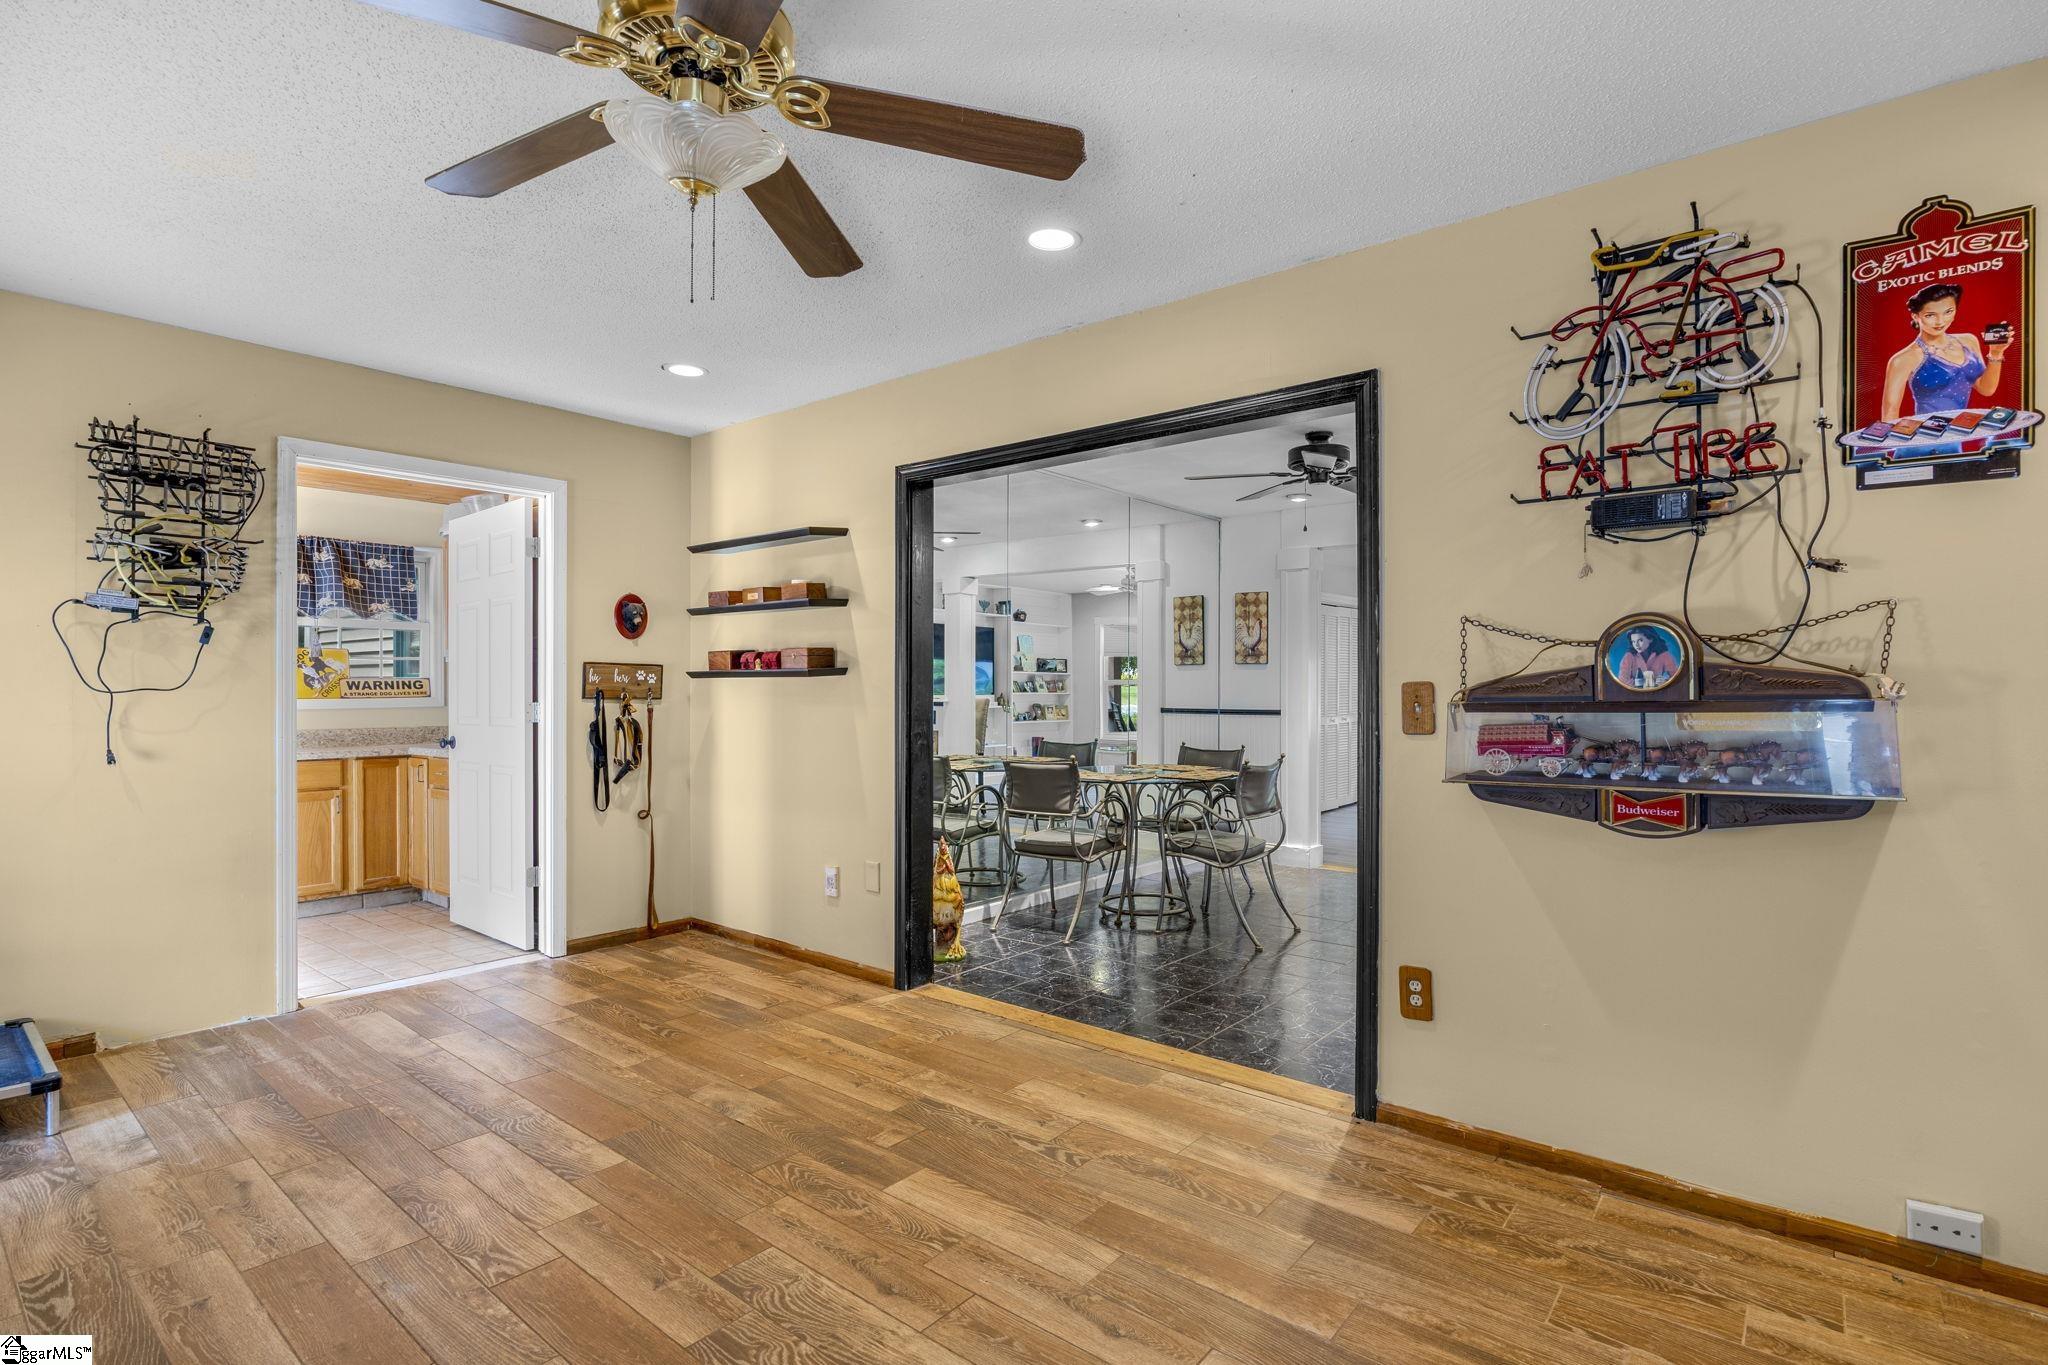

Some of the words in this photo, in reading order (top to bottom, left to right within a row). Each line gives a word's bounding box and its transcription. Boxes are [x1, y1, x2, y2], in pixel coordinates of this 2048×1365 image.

[1852, 230, 2029, 283] CAMEL
[1877, 271, 1935, 292] EXOTIC
[1938, 257, 2004, 279] BLENDS
[1540, 442, 1641, 500] FAT
[1652, 421, 1779, 483] TIRE
[346, 679, 424, 691] WARNING
[614, 667, 630, 684] hers
[1617, 804, 1680, 817] Budweiser
